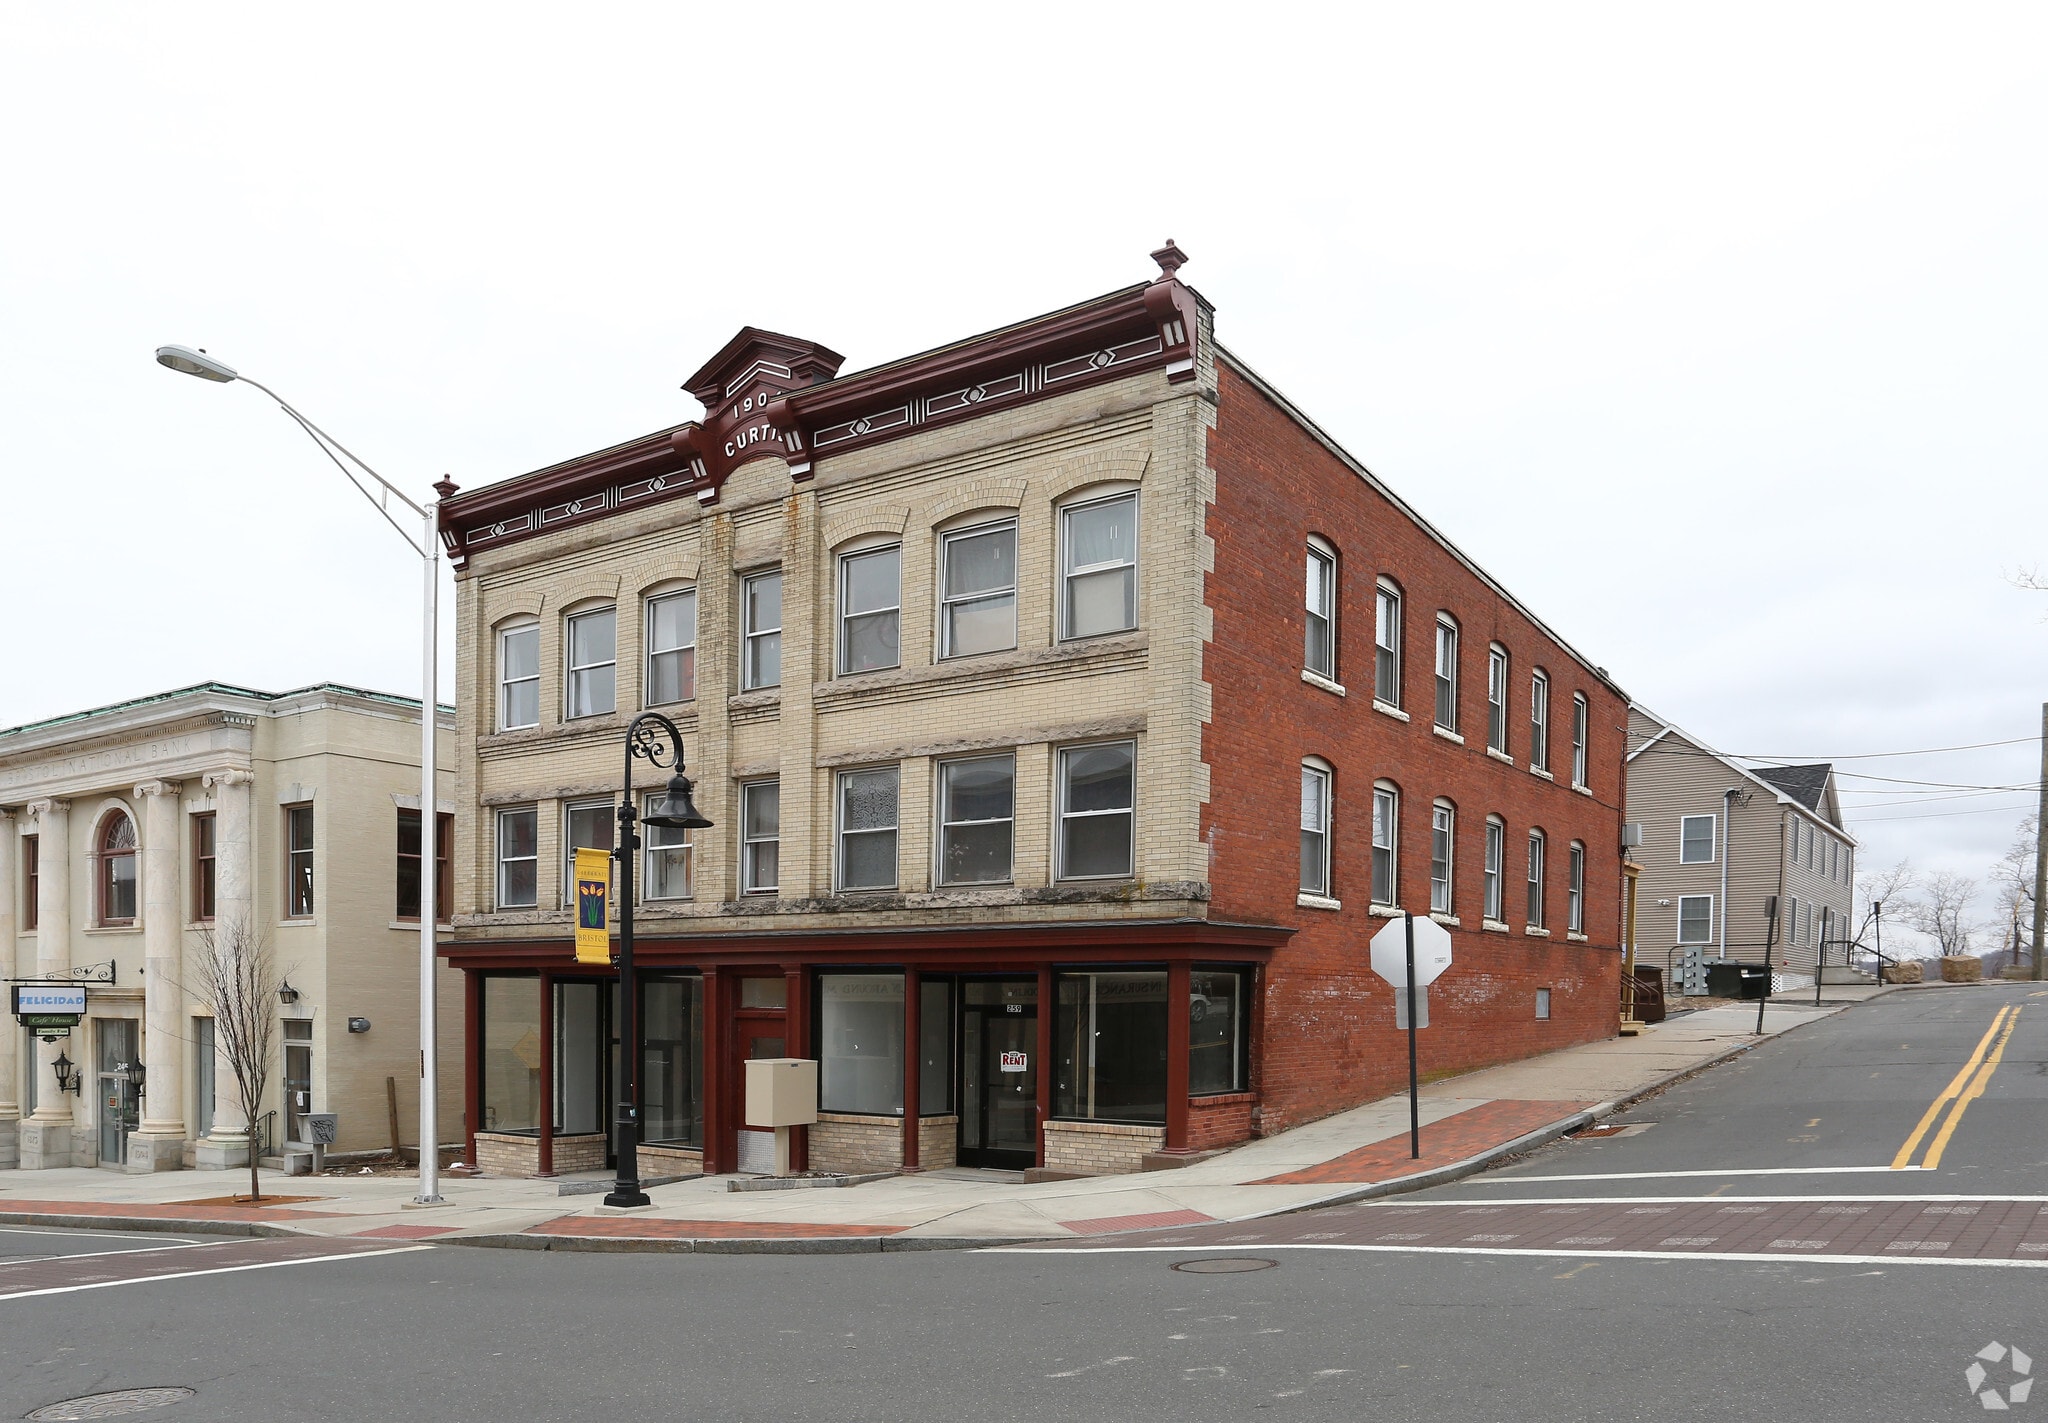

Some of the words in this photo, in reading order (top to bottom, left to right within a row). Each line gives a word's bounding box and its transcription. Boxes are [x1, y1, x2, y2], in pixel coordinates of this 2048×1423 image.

[733, 391, 782, 419] 190
[724, 423, 784, 458] CURTI
[68, 749, 141, 774] NATIONAL
[151, 737, 192, 759] BANK
[578, 934, 607, 942] BRISTOL
[19, 996, 84, 1005] FELICIDAD
[1002, 1054, 1026, 1066] RENT
